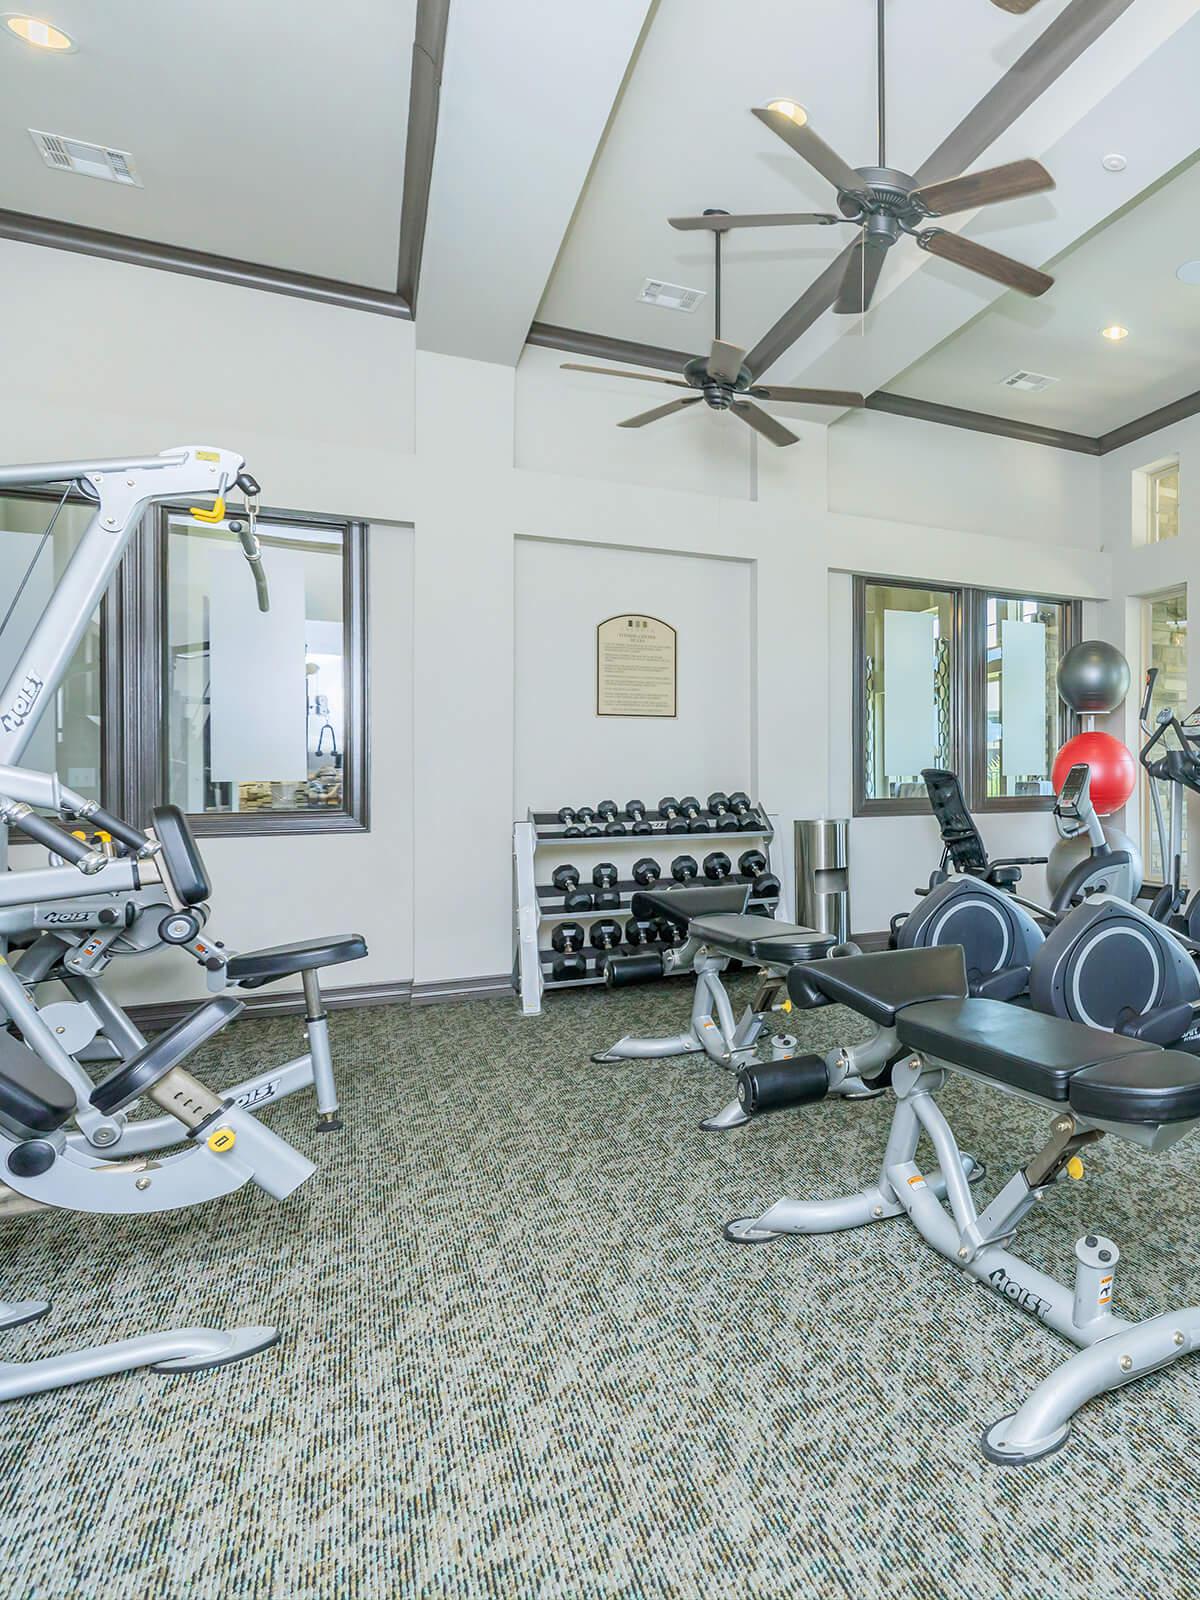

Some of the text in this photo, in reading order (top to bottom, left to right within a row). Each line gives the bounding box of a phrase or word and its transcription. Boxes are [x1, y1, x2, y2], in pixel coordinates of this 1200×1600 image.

[0, 671, 44, 732] HOIST
[44, 911, 97, 923] HOIST
[234, 1079, 281, 1110] OIST
[988, 1268, 1052, 1319] HOIST
